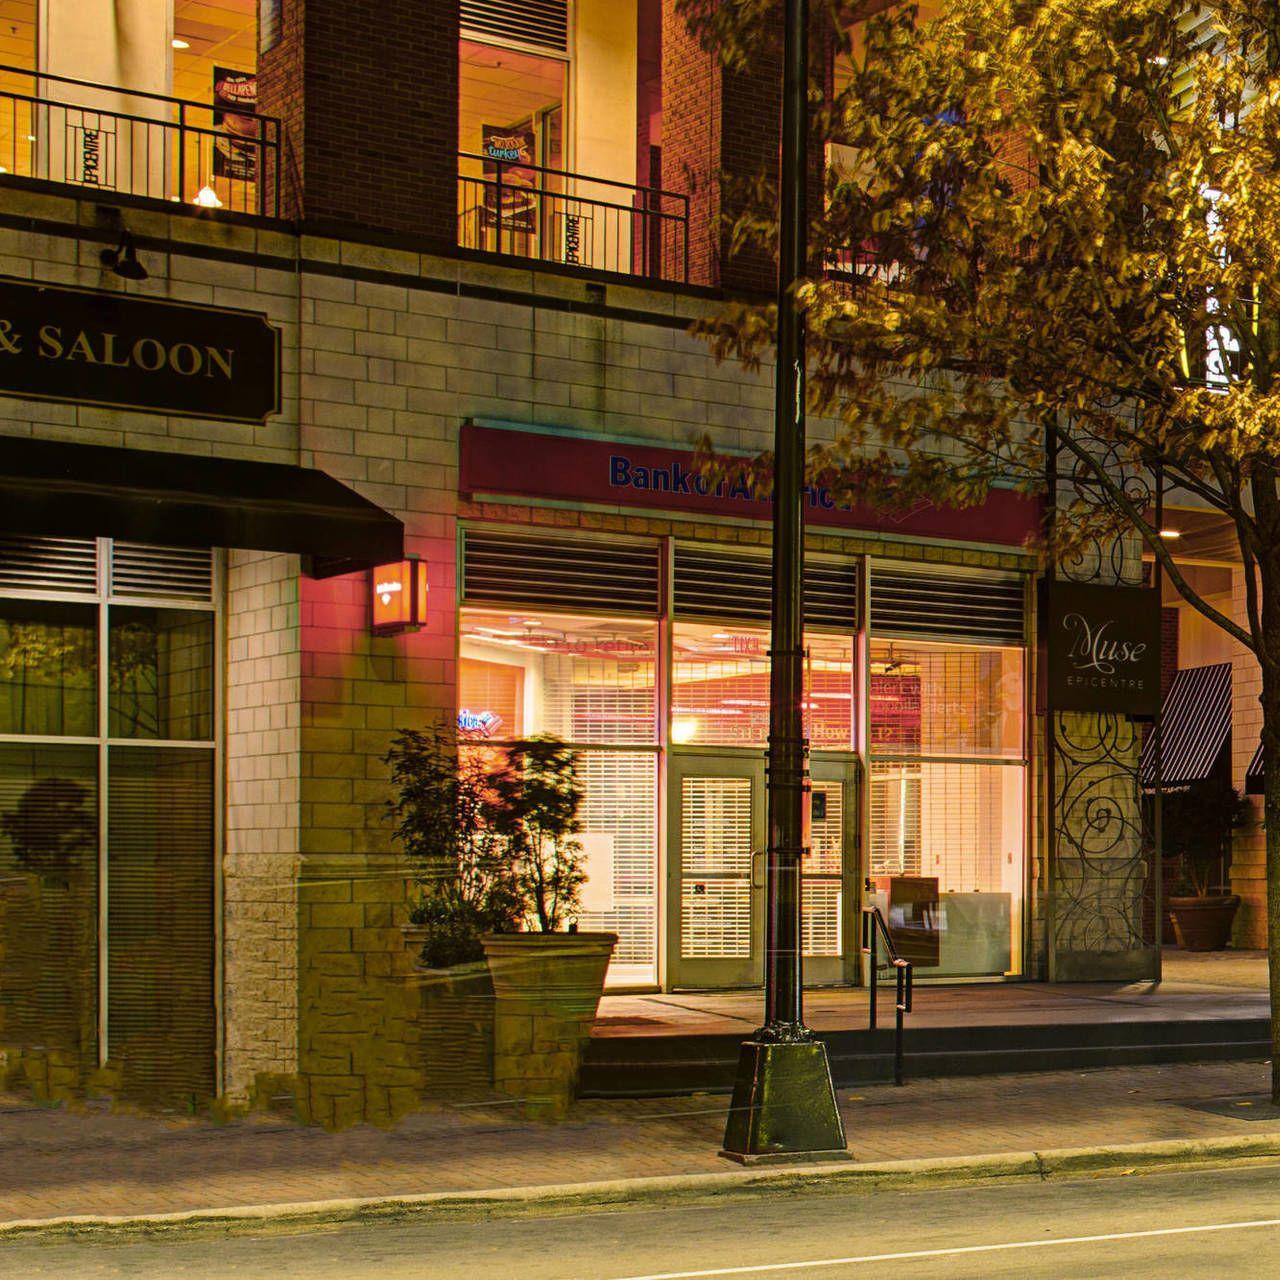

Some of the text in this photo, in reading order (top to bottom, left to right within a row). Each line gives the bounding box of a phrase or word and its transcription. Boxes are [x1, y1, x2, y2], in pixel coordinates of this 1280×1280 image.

[38, 324, 236, 381] SALOON
[608, 454, 693, 496] Bank
[1063, 612, 1147, 675] Muse
[1066, 675, 1145, 690] EPICENTRE
